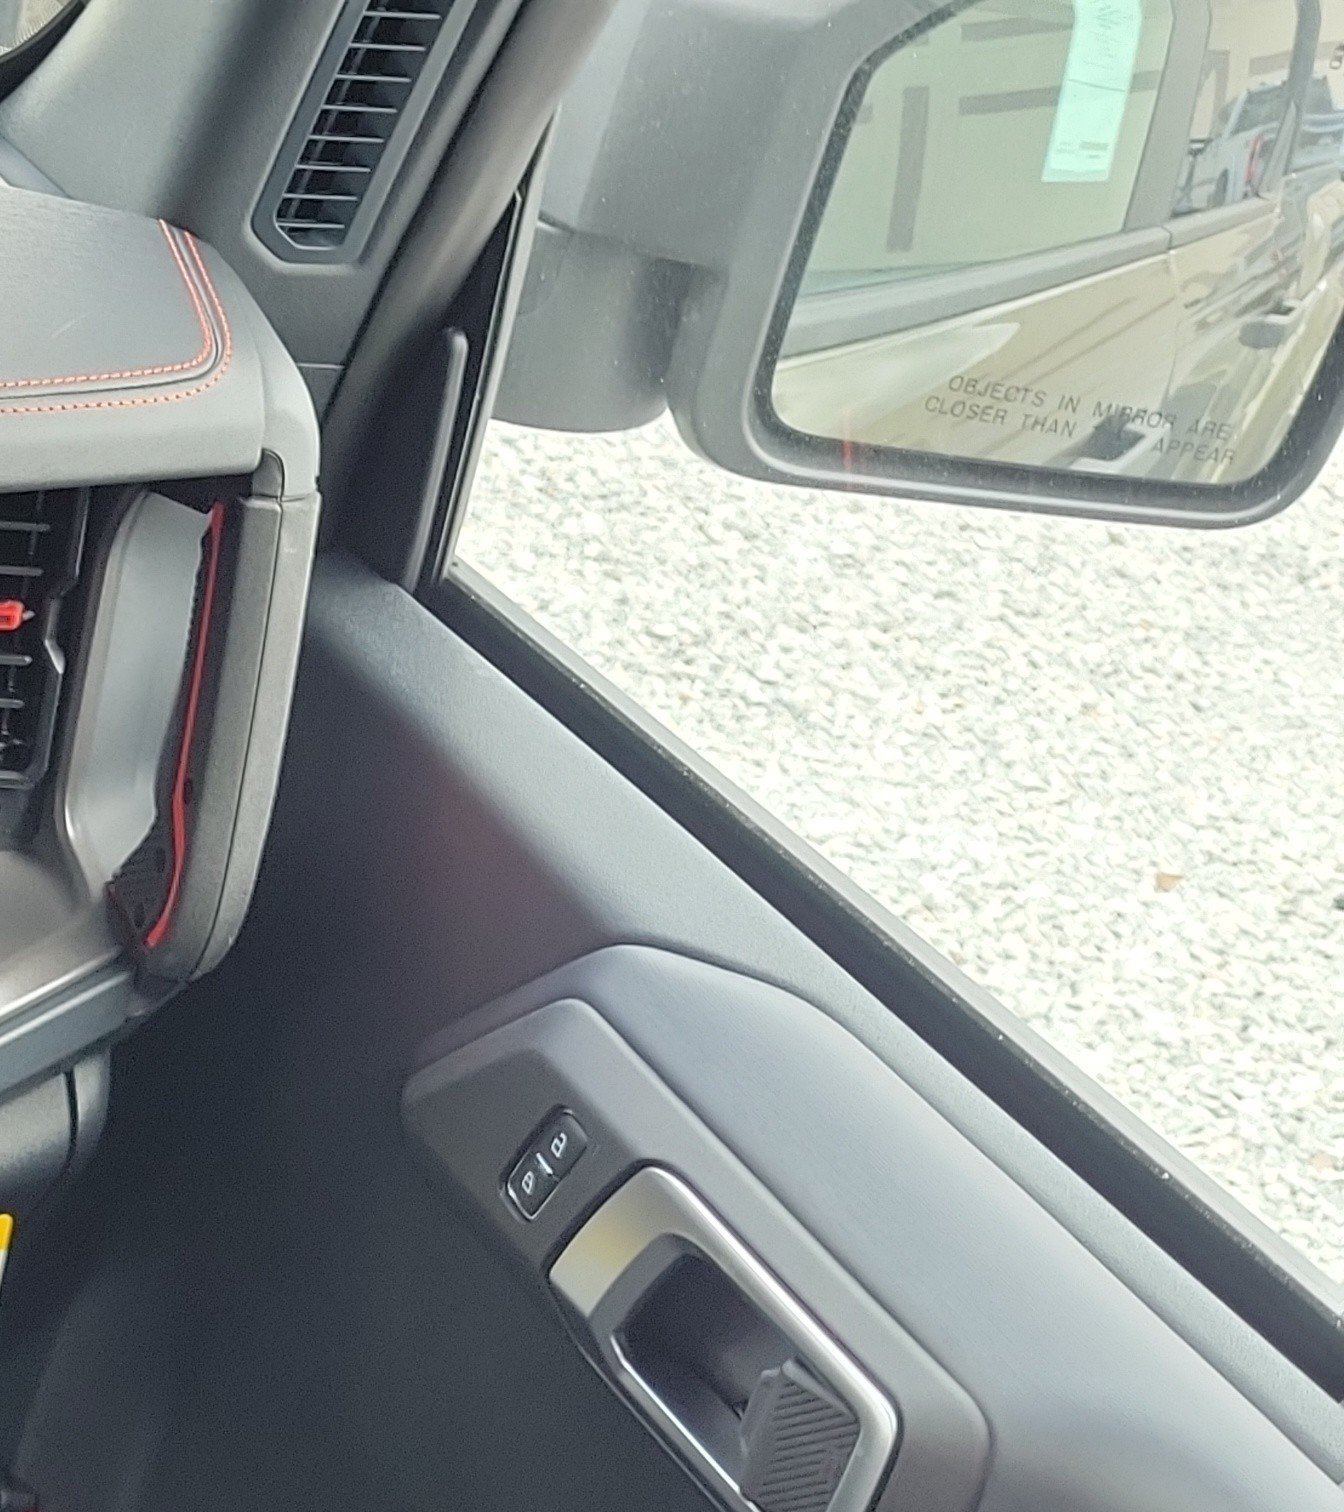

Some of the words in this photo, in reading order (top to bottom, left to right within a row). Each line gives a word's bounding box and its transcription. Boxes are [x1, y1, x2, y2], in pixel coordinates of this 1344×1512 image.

[925, 395, 1008, 426] CLOSER
[1021, 412, 1077, 438] THAN
[1153, 436, 1235, 465] APPEAR
[948, 375, 1047, 407] OBJECTS
[1057, 394, 1081, 414] IN
[1092, 400, 1177, 431] MIRROR
[1186, 419, 1232, 441] ARE
